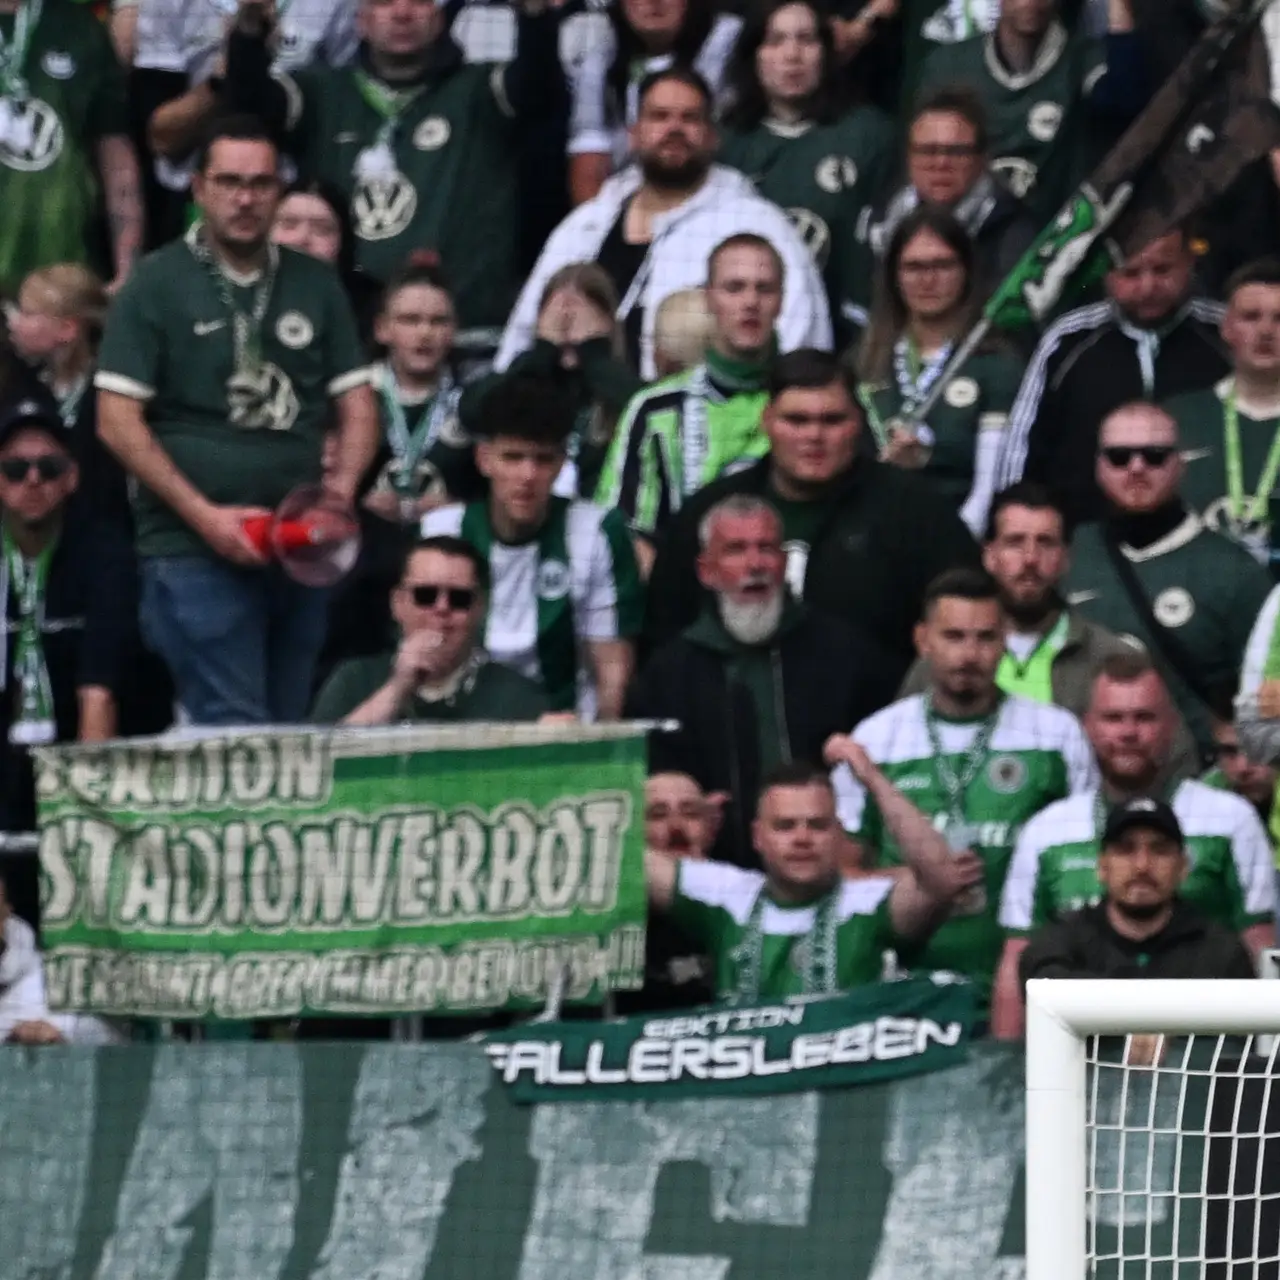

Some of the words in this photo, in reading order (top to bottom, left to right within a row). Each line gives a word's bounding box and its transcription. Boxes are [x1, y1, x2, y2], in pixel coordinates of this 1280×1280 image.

[40, 798, 627, 927] STADIONVERBOT
[485, 1016, 961, 1085] FALLERSLEBEN
[643, 1004, 806, 1039] SEKTION
